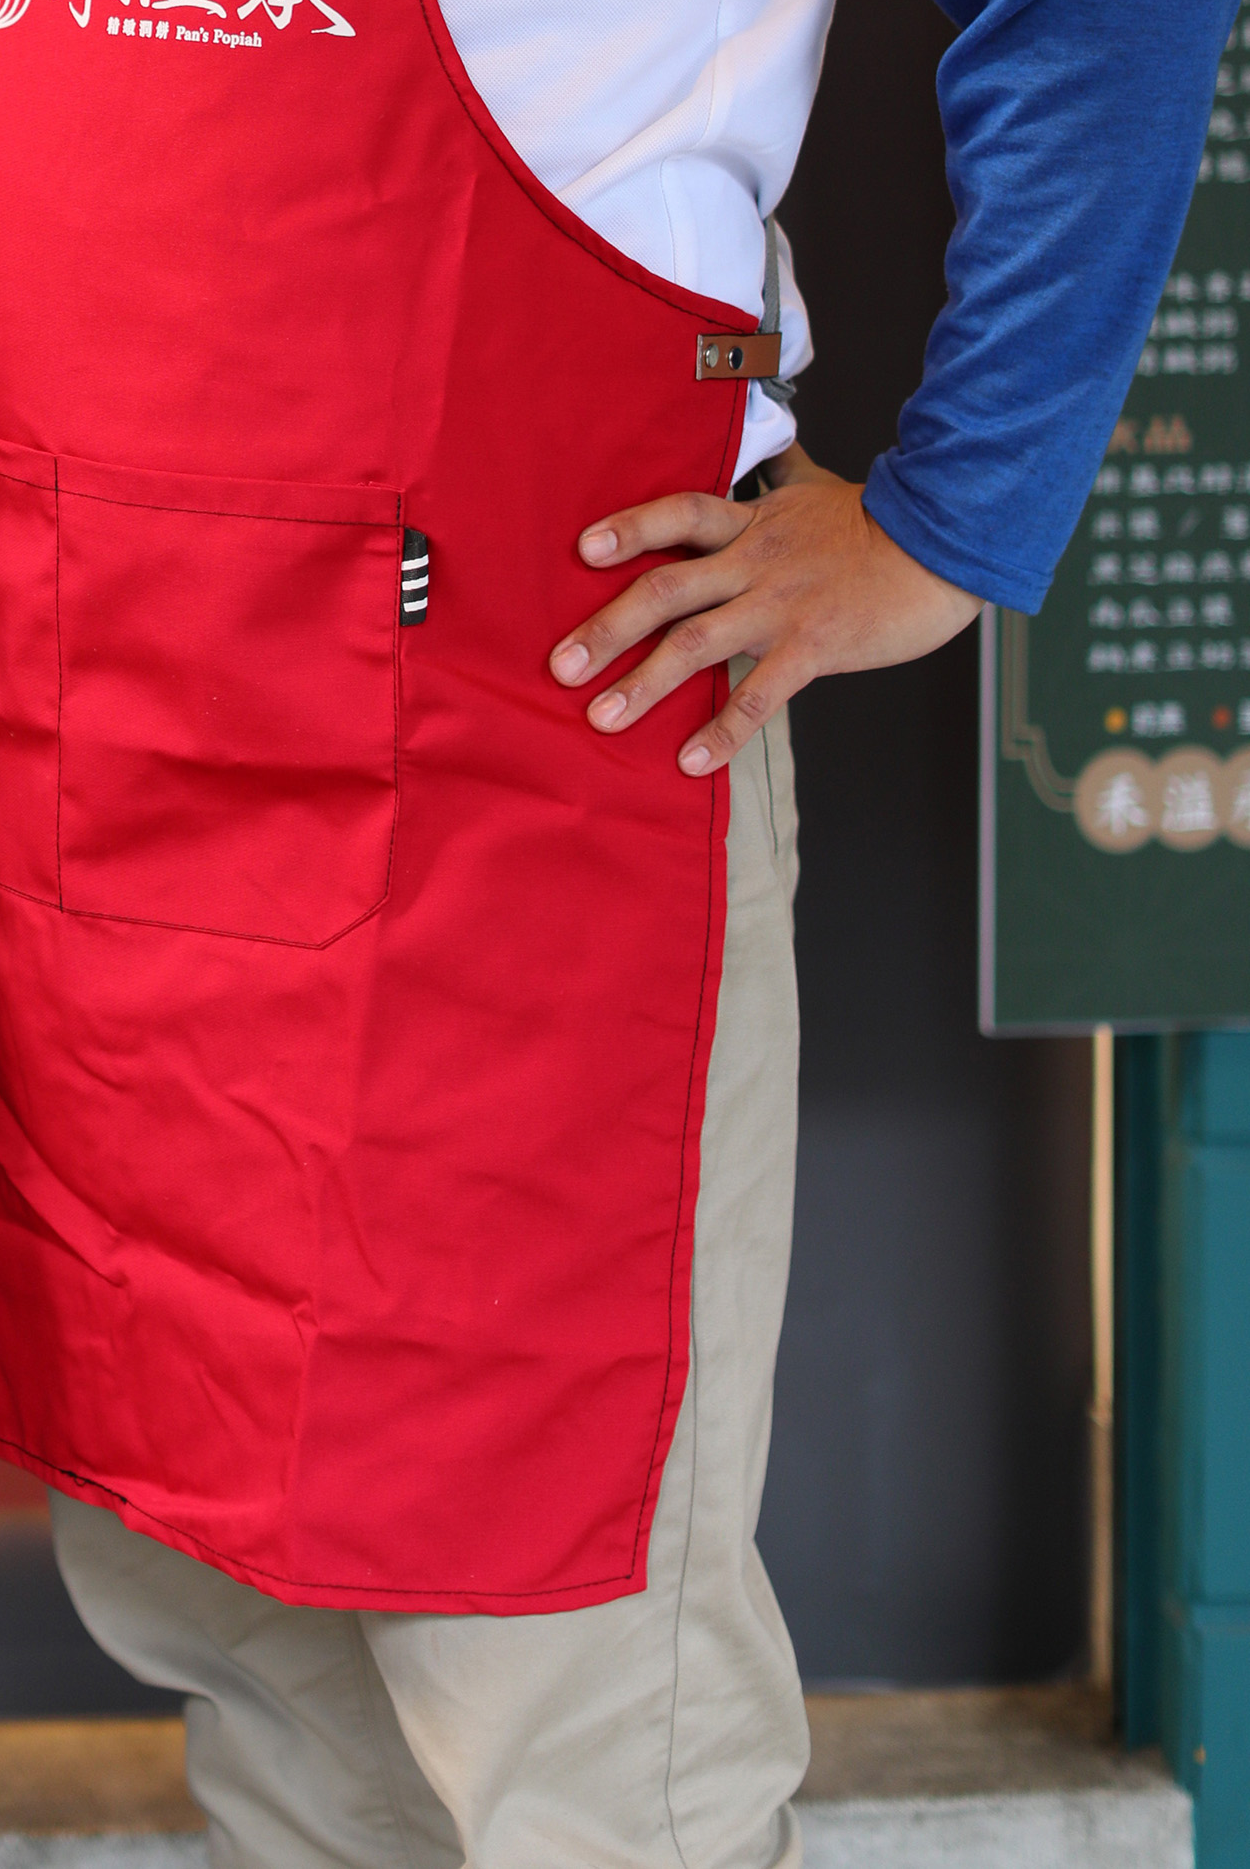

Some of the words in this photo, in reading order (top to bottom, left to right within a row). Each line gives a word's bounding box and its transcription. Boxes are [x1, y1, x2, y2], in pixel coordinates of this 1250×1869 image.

[175, 25, 210, 43] Pan's
[212, 28, 263, 49] Popiah
[1095, 770, 1250, 837] 禾溢
